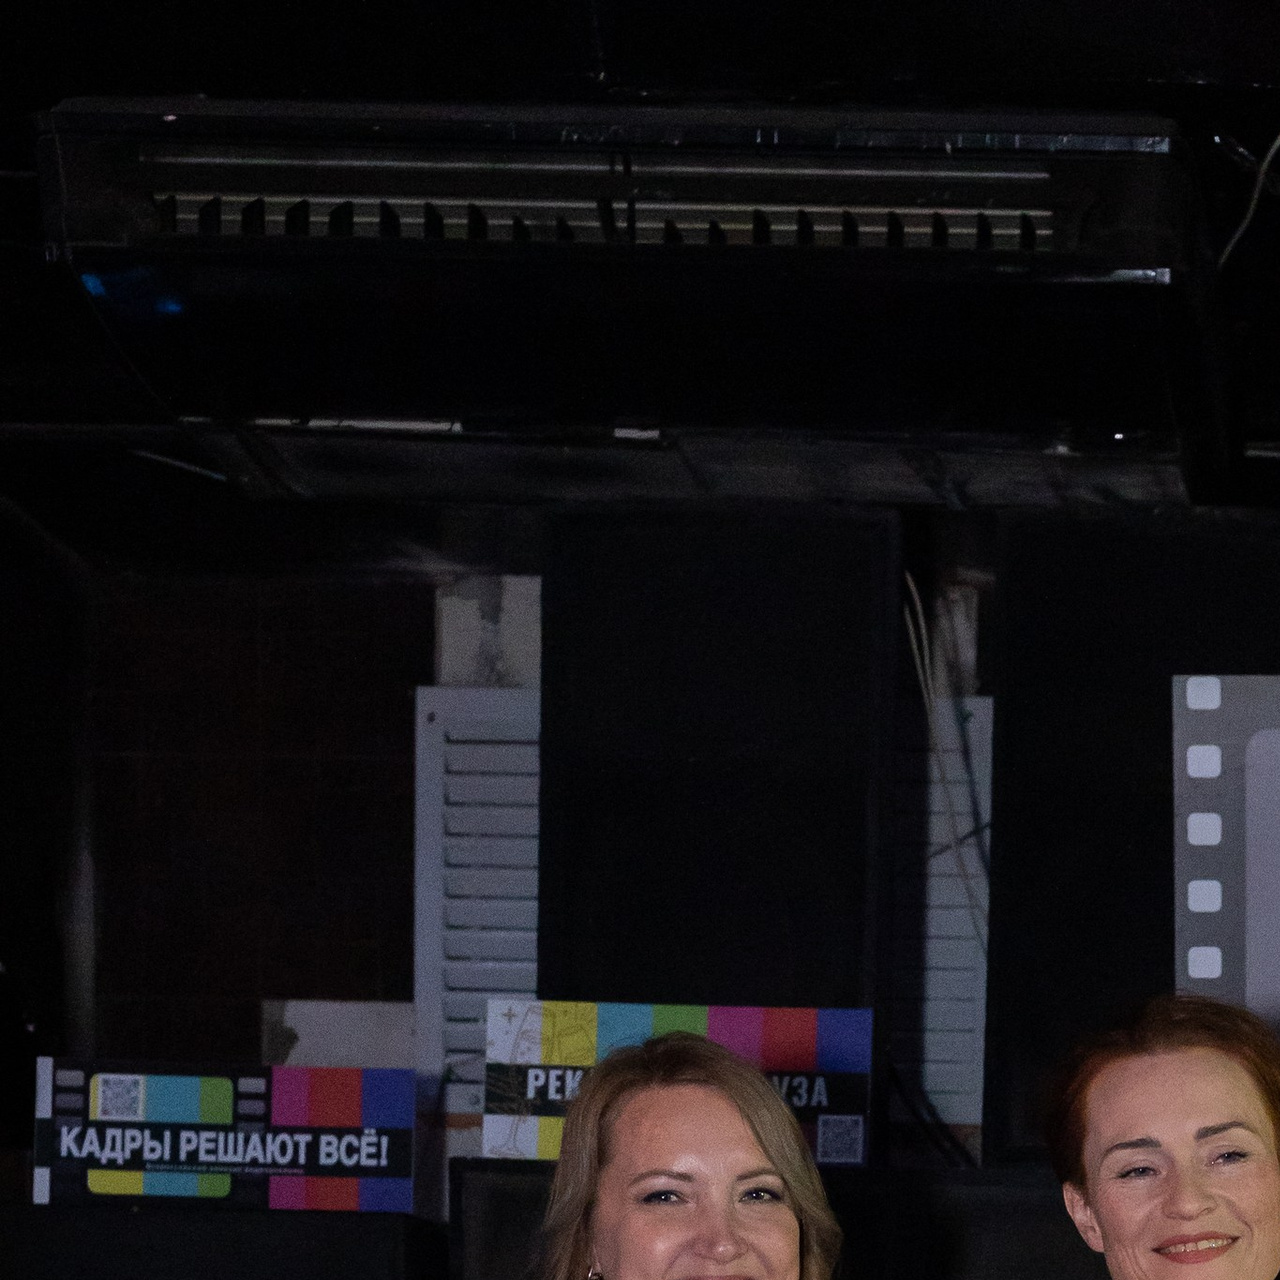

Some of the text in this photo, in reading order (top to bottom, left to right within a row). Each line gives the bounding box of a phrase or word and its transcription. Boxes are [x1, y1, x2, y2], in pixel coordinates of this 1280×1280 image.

[771, 1075, 828, 1107] УЗА
[59, 1126, 389, 1167] КАДРЫ РЕШАЮТ ВСЁ!
